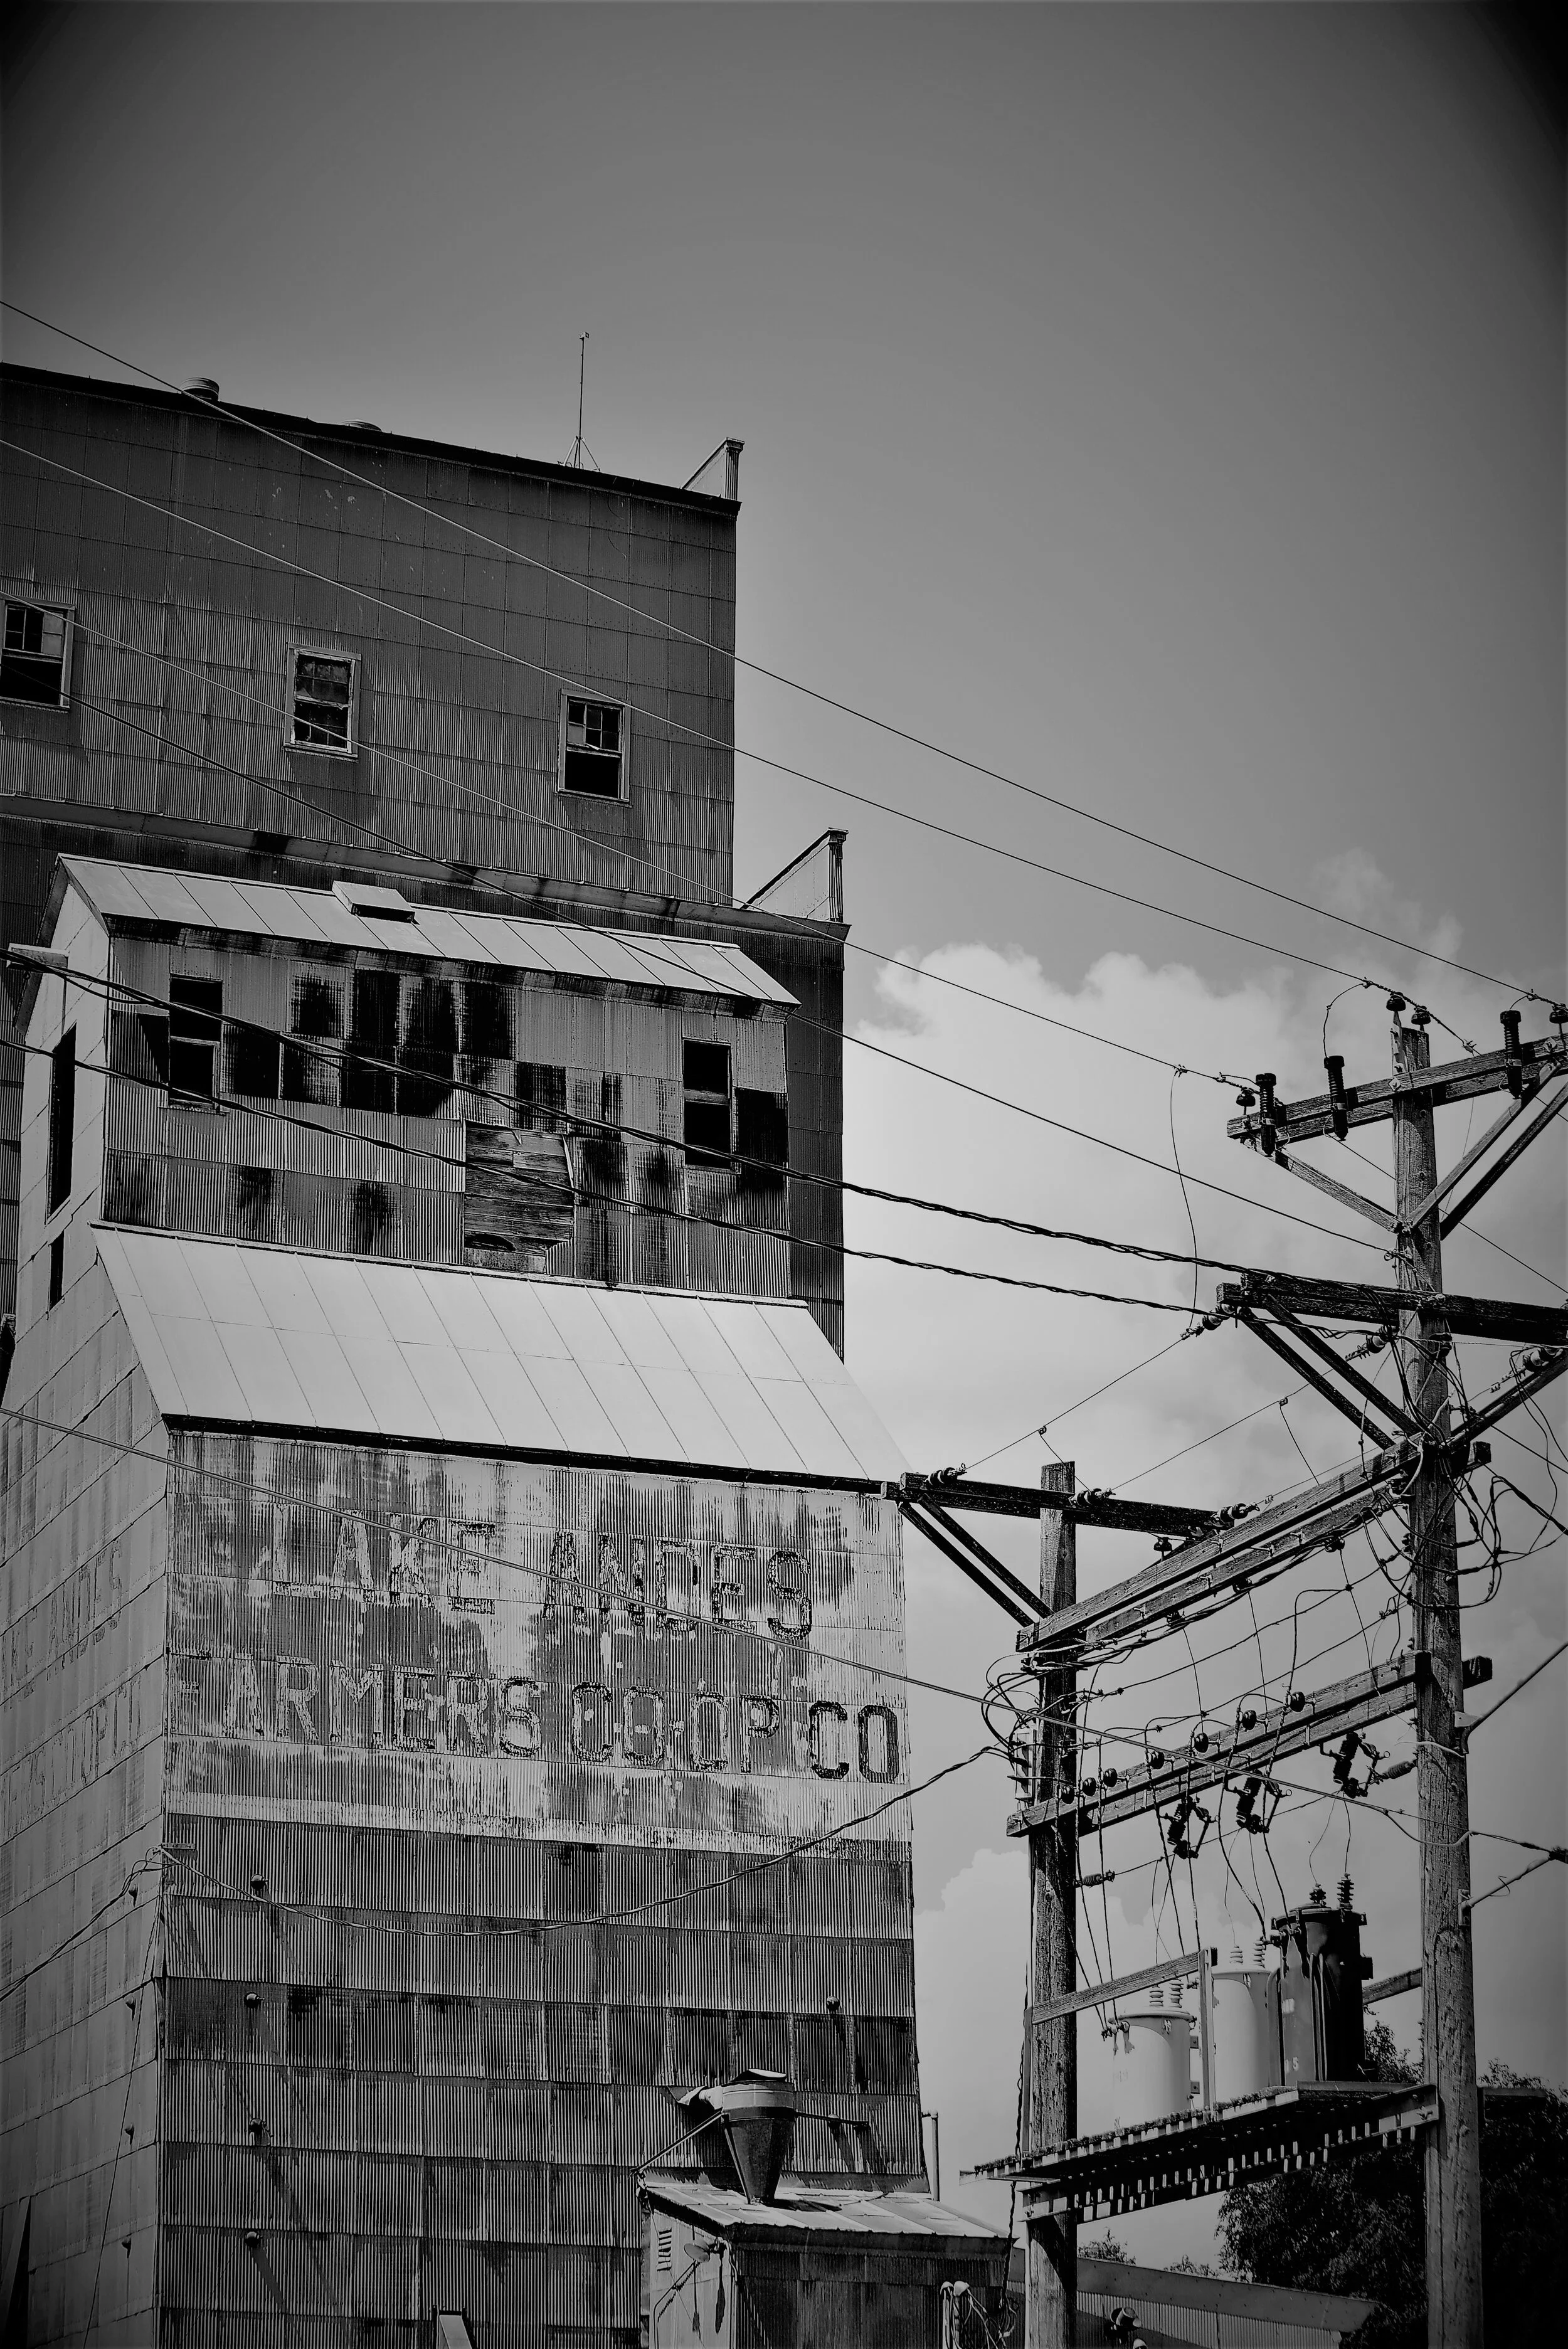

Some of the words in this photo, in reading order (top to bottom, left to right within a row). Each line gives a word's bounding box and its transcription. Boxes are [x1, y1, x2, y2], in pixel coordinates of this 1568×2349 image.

[272, 1503, 494, 1615] LAKE
[543, 1532, 811, 1641] ANDES
[168, 1651, 541, 1758] FARMERS
[810, 1700, 899, 1783] CO
